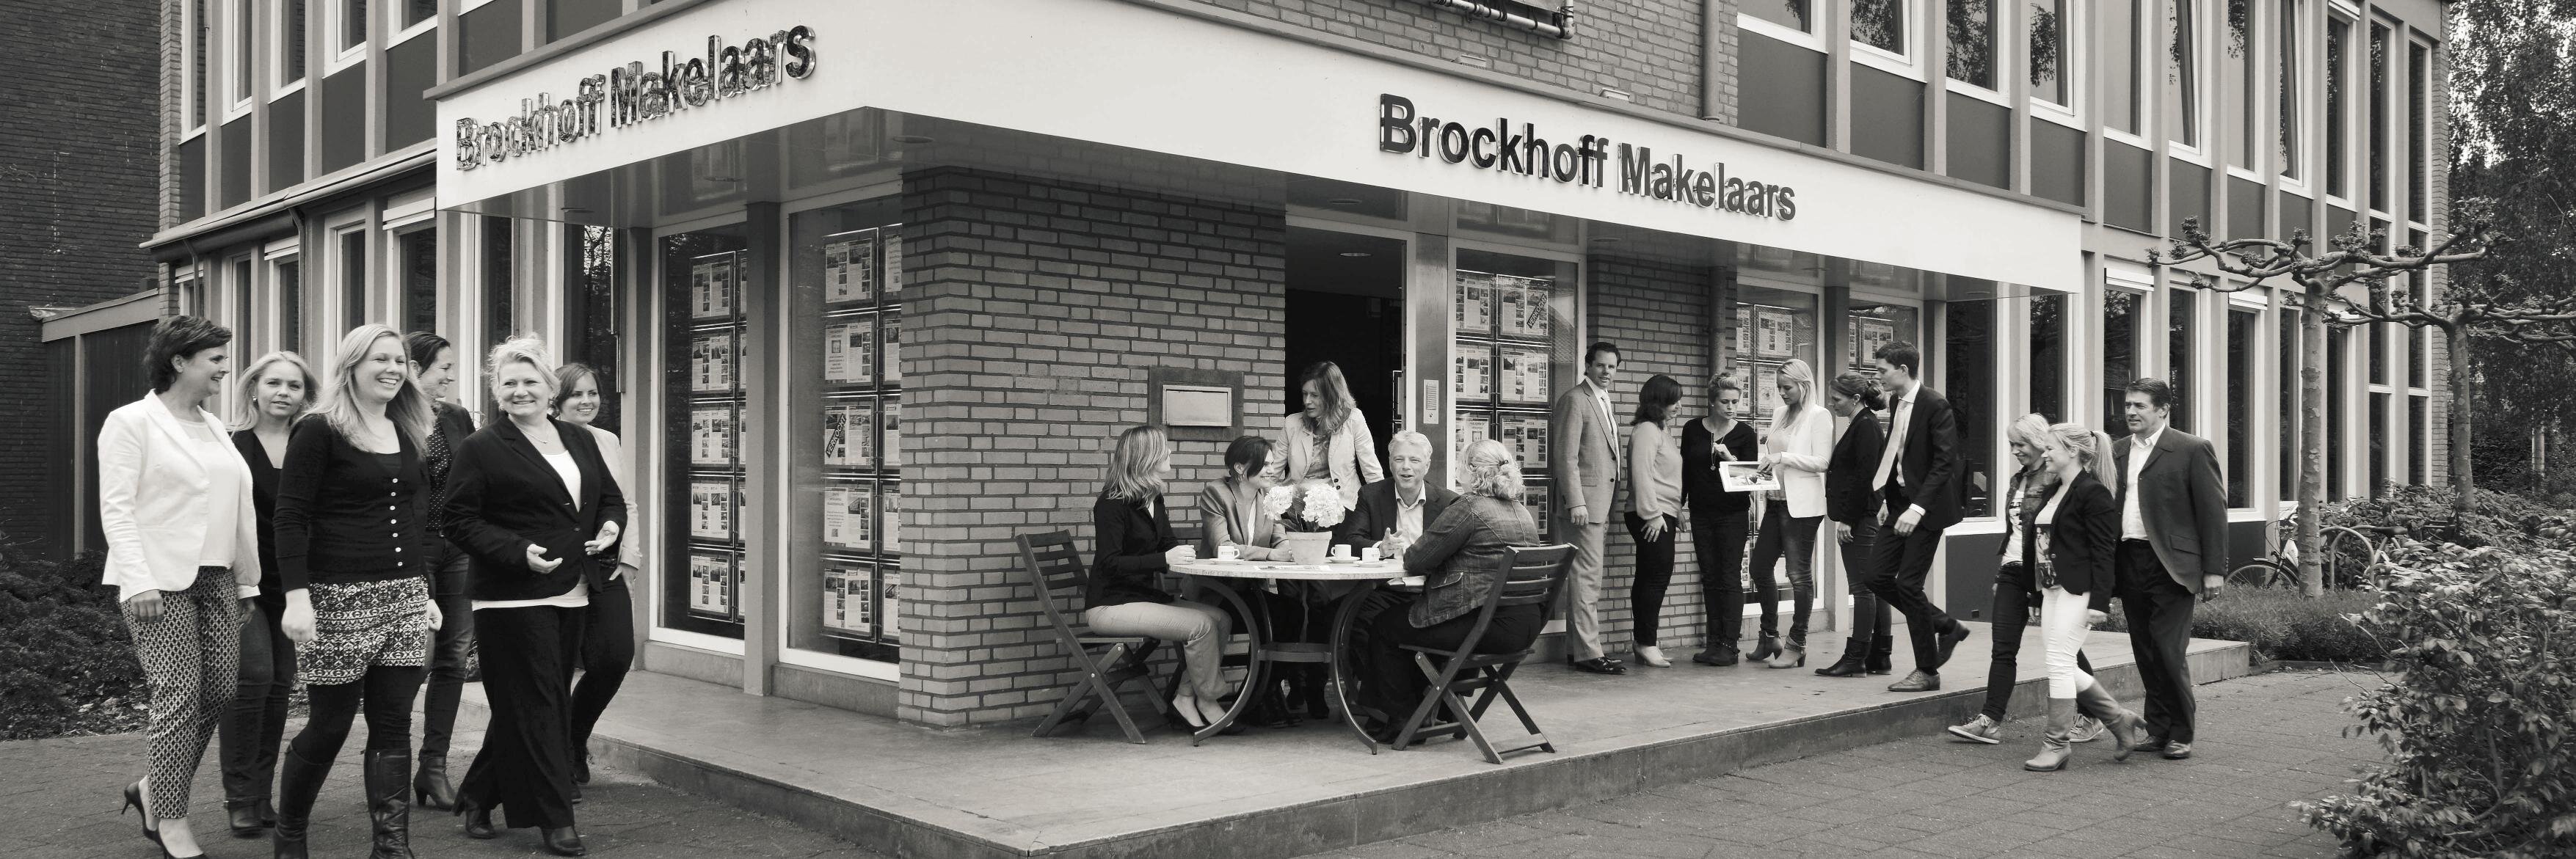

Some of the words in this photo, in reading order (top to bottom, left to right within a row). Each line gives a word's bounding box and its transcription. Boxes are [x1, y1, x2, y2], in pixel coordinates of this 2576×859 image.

[456, 74, 605, 170] Brockhoff
[611, 25, 816, 128] Makelaars
[1380, 93, 1609, 188] Brockhoff
[1618, 142, 1796, 221] Makelaars
[1527, 294, 1547, 327] VERKOCHT
[826, 414, 846, 456] VERKOCHT
